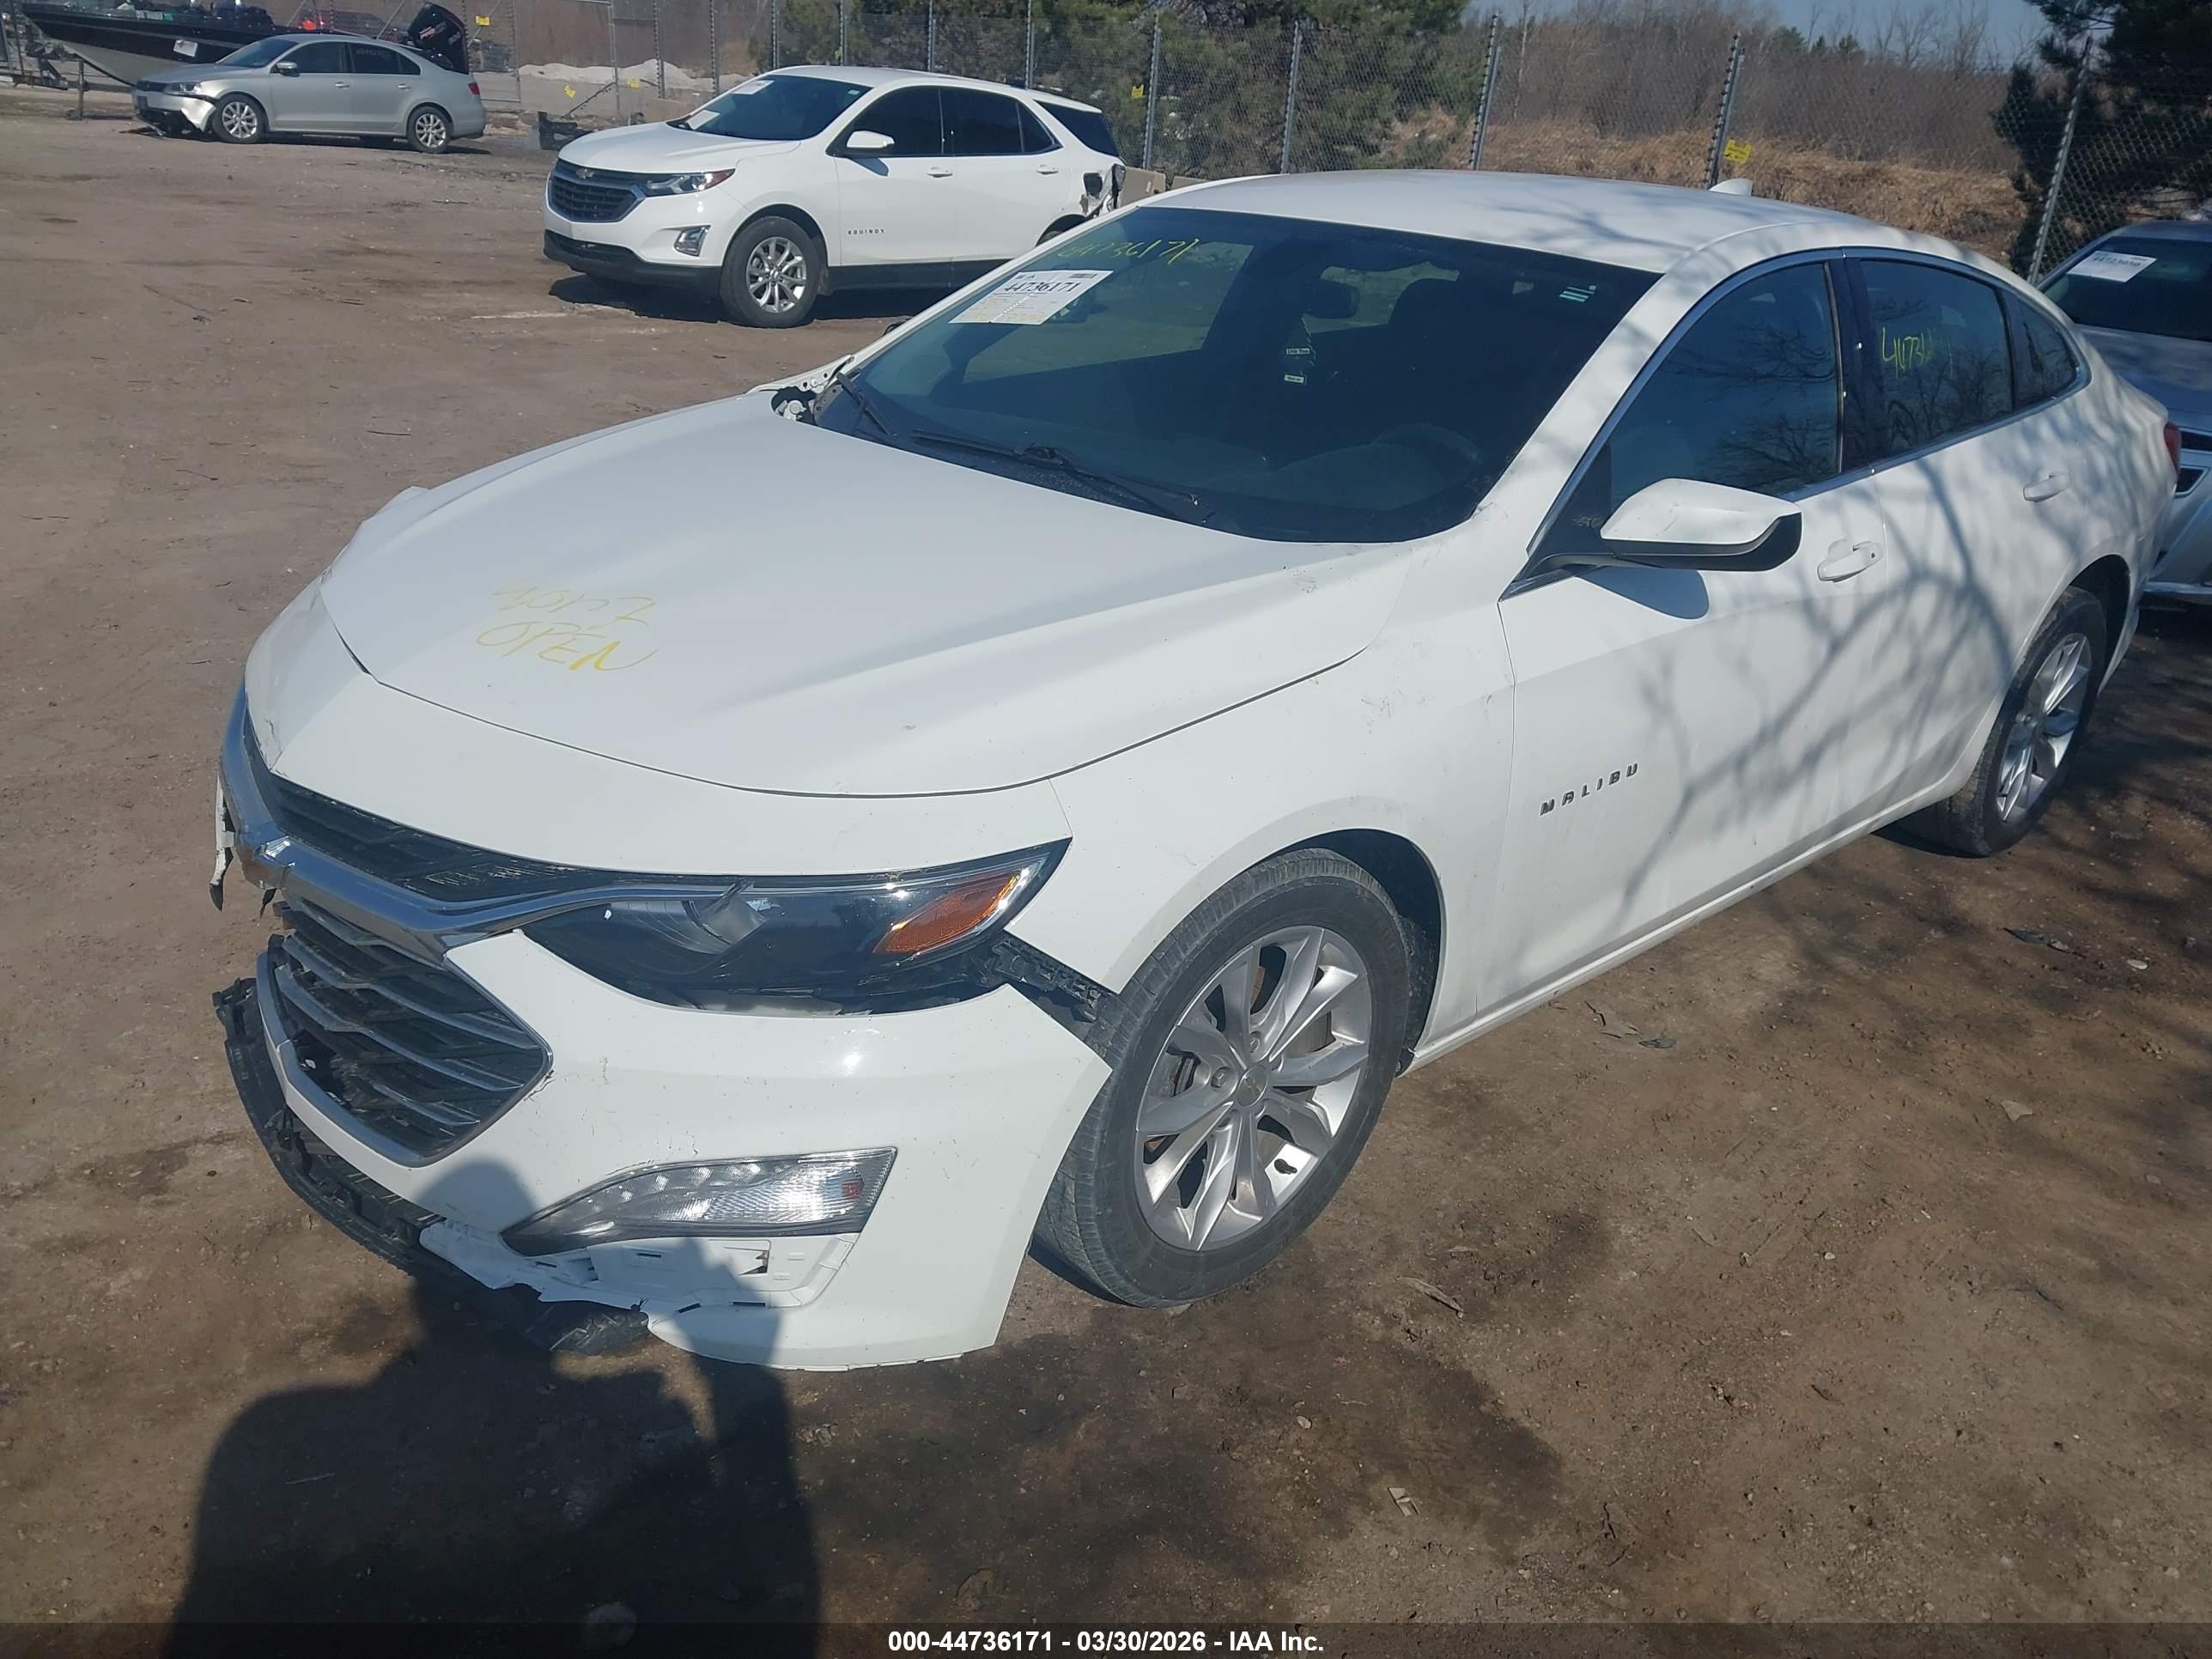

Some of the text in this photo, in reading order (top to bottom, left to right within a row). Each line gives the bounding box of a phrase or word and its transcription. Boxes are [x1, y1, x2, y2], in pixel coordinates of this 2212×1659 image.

[1003, 282, 1081, 292] 44736171
[476, 620, 659, 672] OPEN
[1539, 762, 1638, 817] MALIBU
